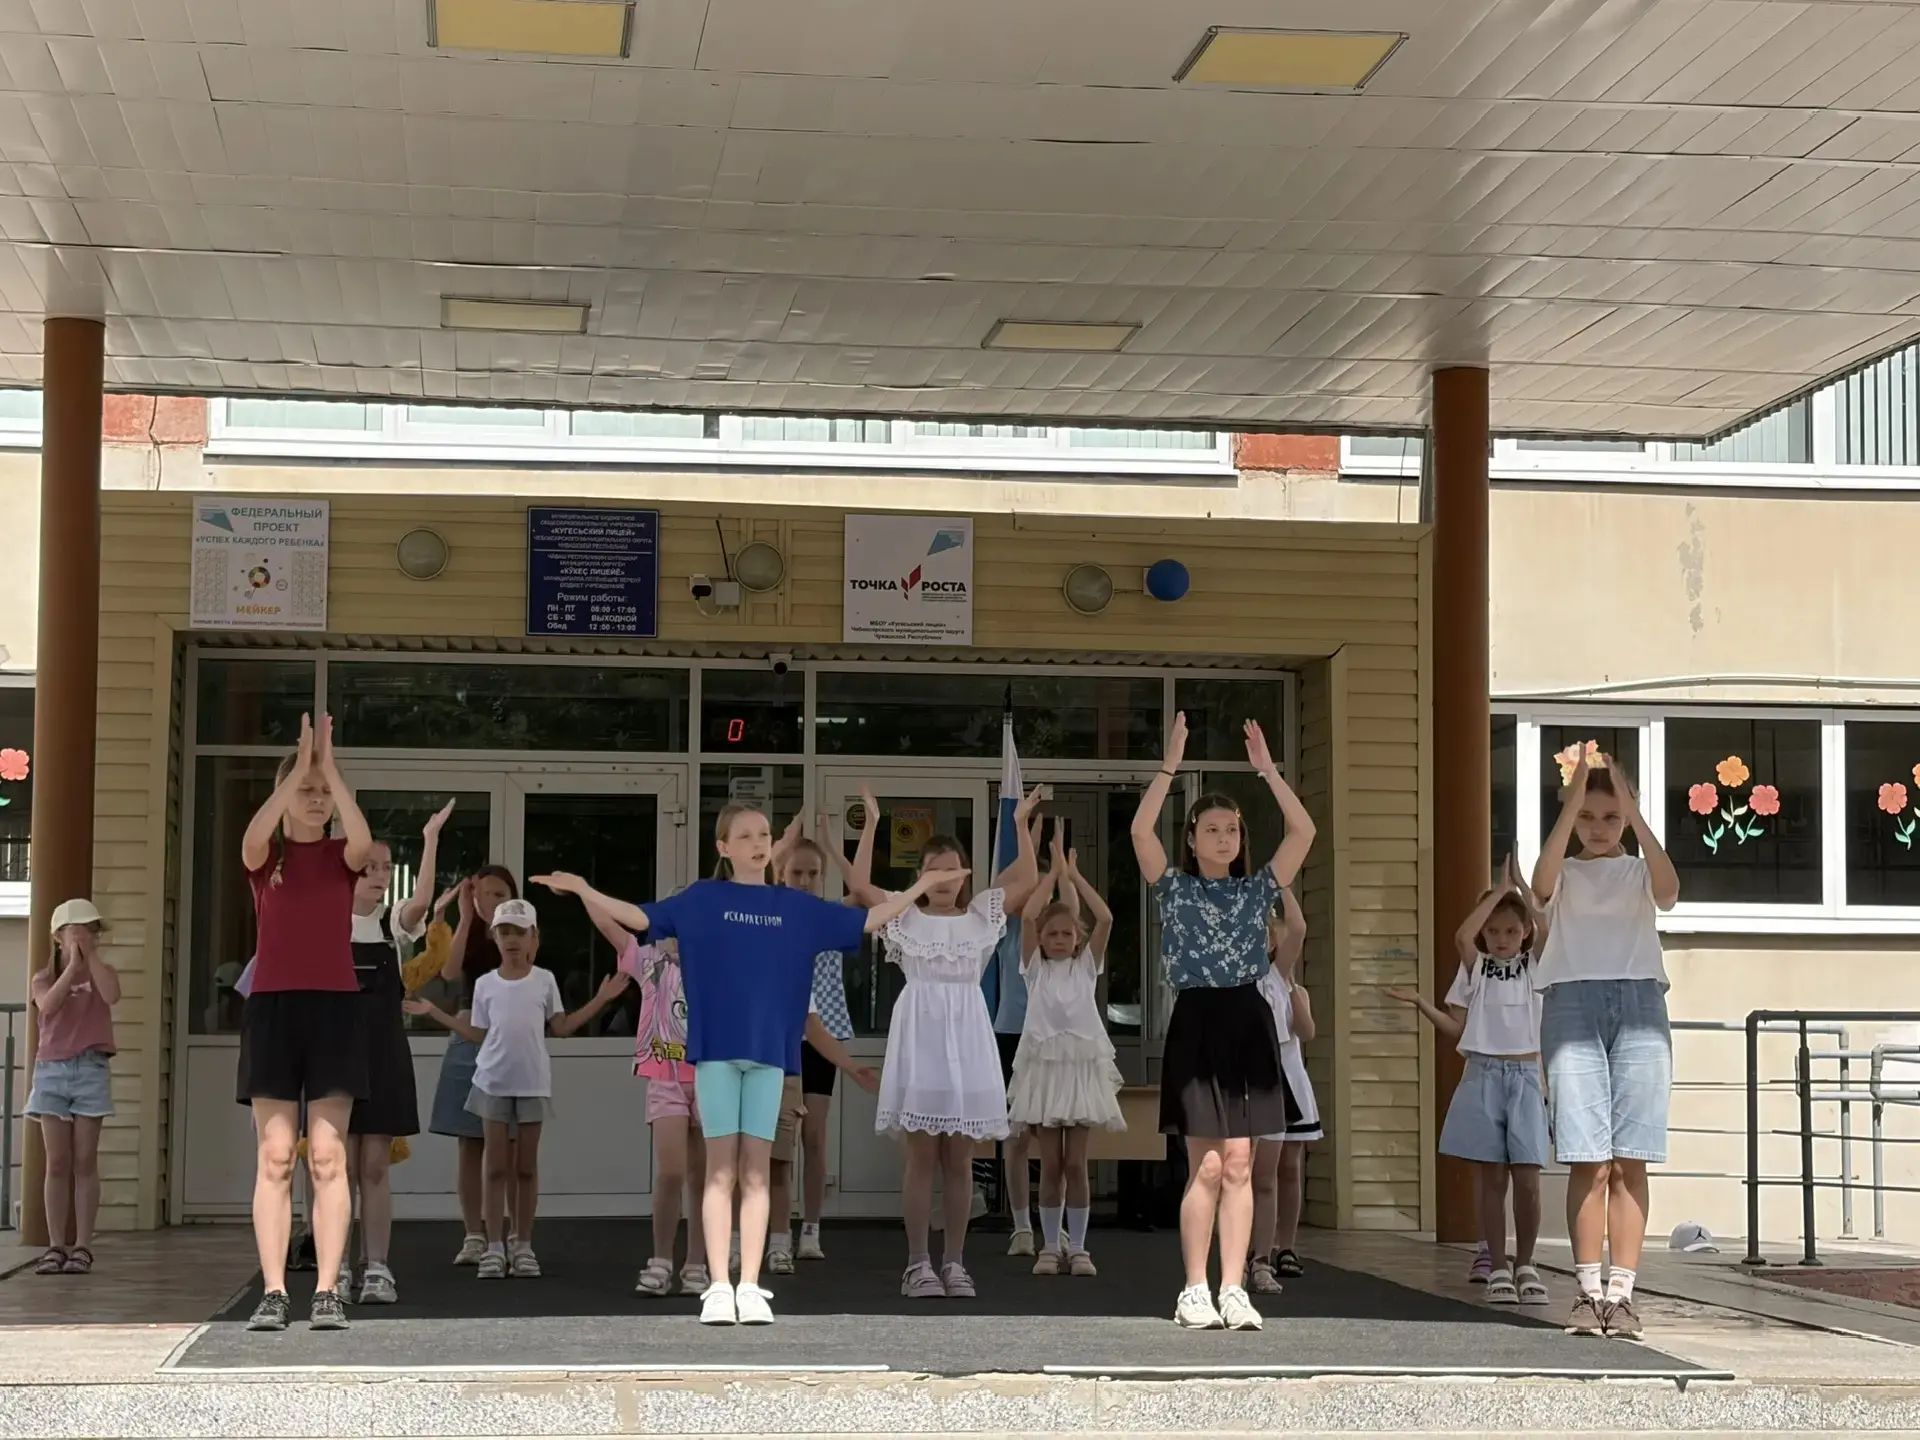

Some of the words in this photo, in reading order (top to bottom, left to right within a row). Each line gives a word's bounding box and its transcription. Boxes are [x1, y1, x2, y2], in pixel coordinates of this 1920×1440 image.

[231, 507, 322, 518] ФЕДЕРАЛЬНЫЙ
[253, 522, 300, 533] ПРОЕКТ
[196, 535, 230, 544] «УСПЕХ
[232, 536, 277, 546] КАЖДОГО
[849, 579, 898, 591] ТОЧКА
[921, 581, 967, 593] РОСТА
[557, 592, 588, 602] Режим
[236, 604, 281, 615] МЕЙКЕР
[547, 604, 559, 612] ПН
[565, 604, 576, 612] ПТ
[547, 613, 559, 621] СБ
[591, 613, 637, 623] ВЫХОДНОЙ
[547, 622, 568, 631] Обед
